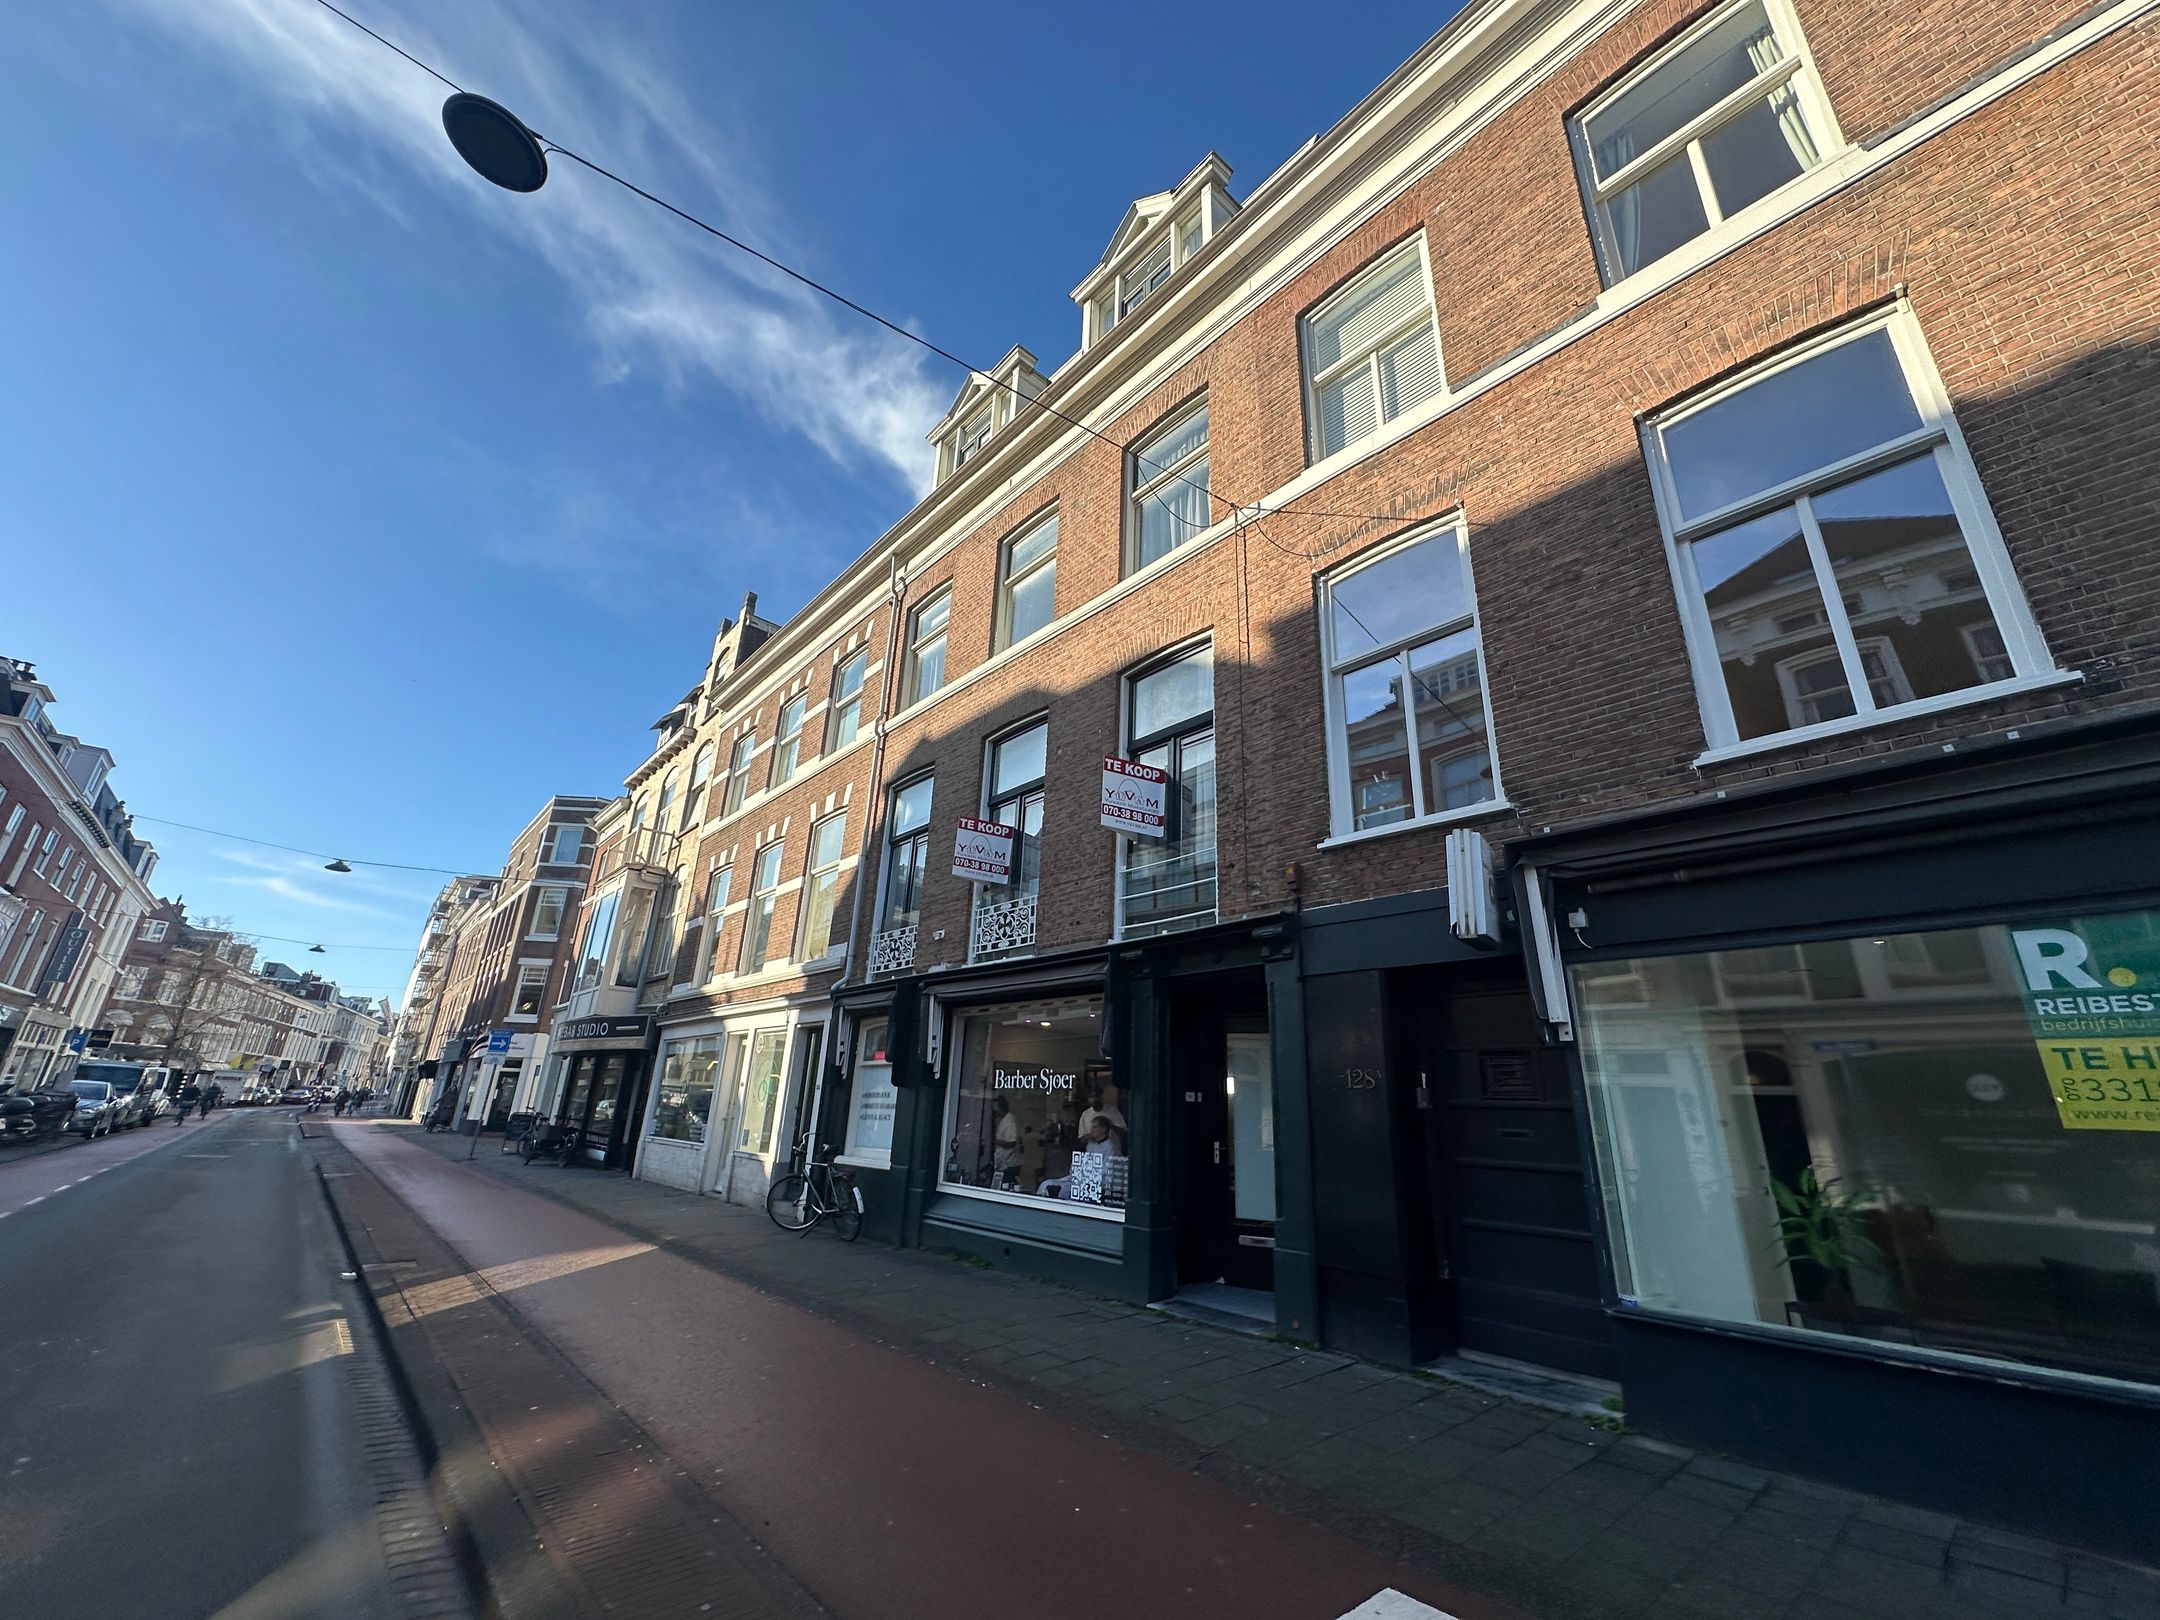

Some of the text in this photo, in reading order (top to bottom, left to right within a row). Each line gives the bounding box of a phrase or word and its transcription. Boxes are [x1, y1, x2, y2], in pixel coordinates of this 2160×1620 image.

[1105, 758, 1160, 780] TE KOOP
[1103, 804, 1131, 819] 070-38
[1132, 812, 1143, 822] 98
[1144, 814, 1159, 825] 000
[960, 818, 1010, 836] TE KOOP
[955, 858, 980, 869] 070-38
[981, 863, 990, 872] 98
[991, 865, 1005, 874] 000
[54, 930, 83, 980] OUTLET
[576, 1022, 609, 1037] STUDIO
[71, 1038, 80, 1047] P
[2051, 1047, 2109, 1070] TE
[994, 1068, 1076, 1095] Barber Sjoer
[2062, 1077, 2160, 1102] 070 331
